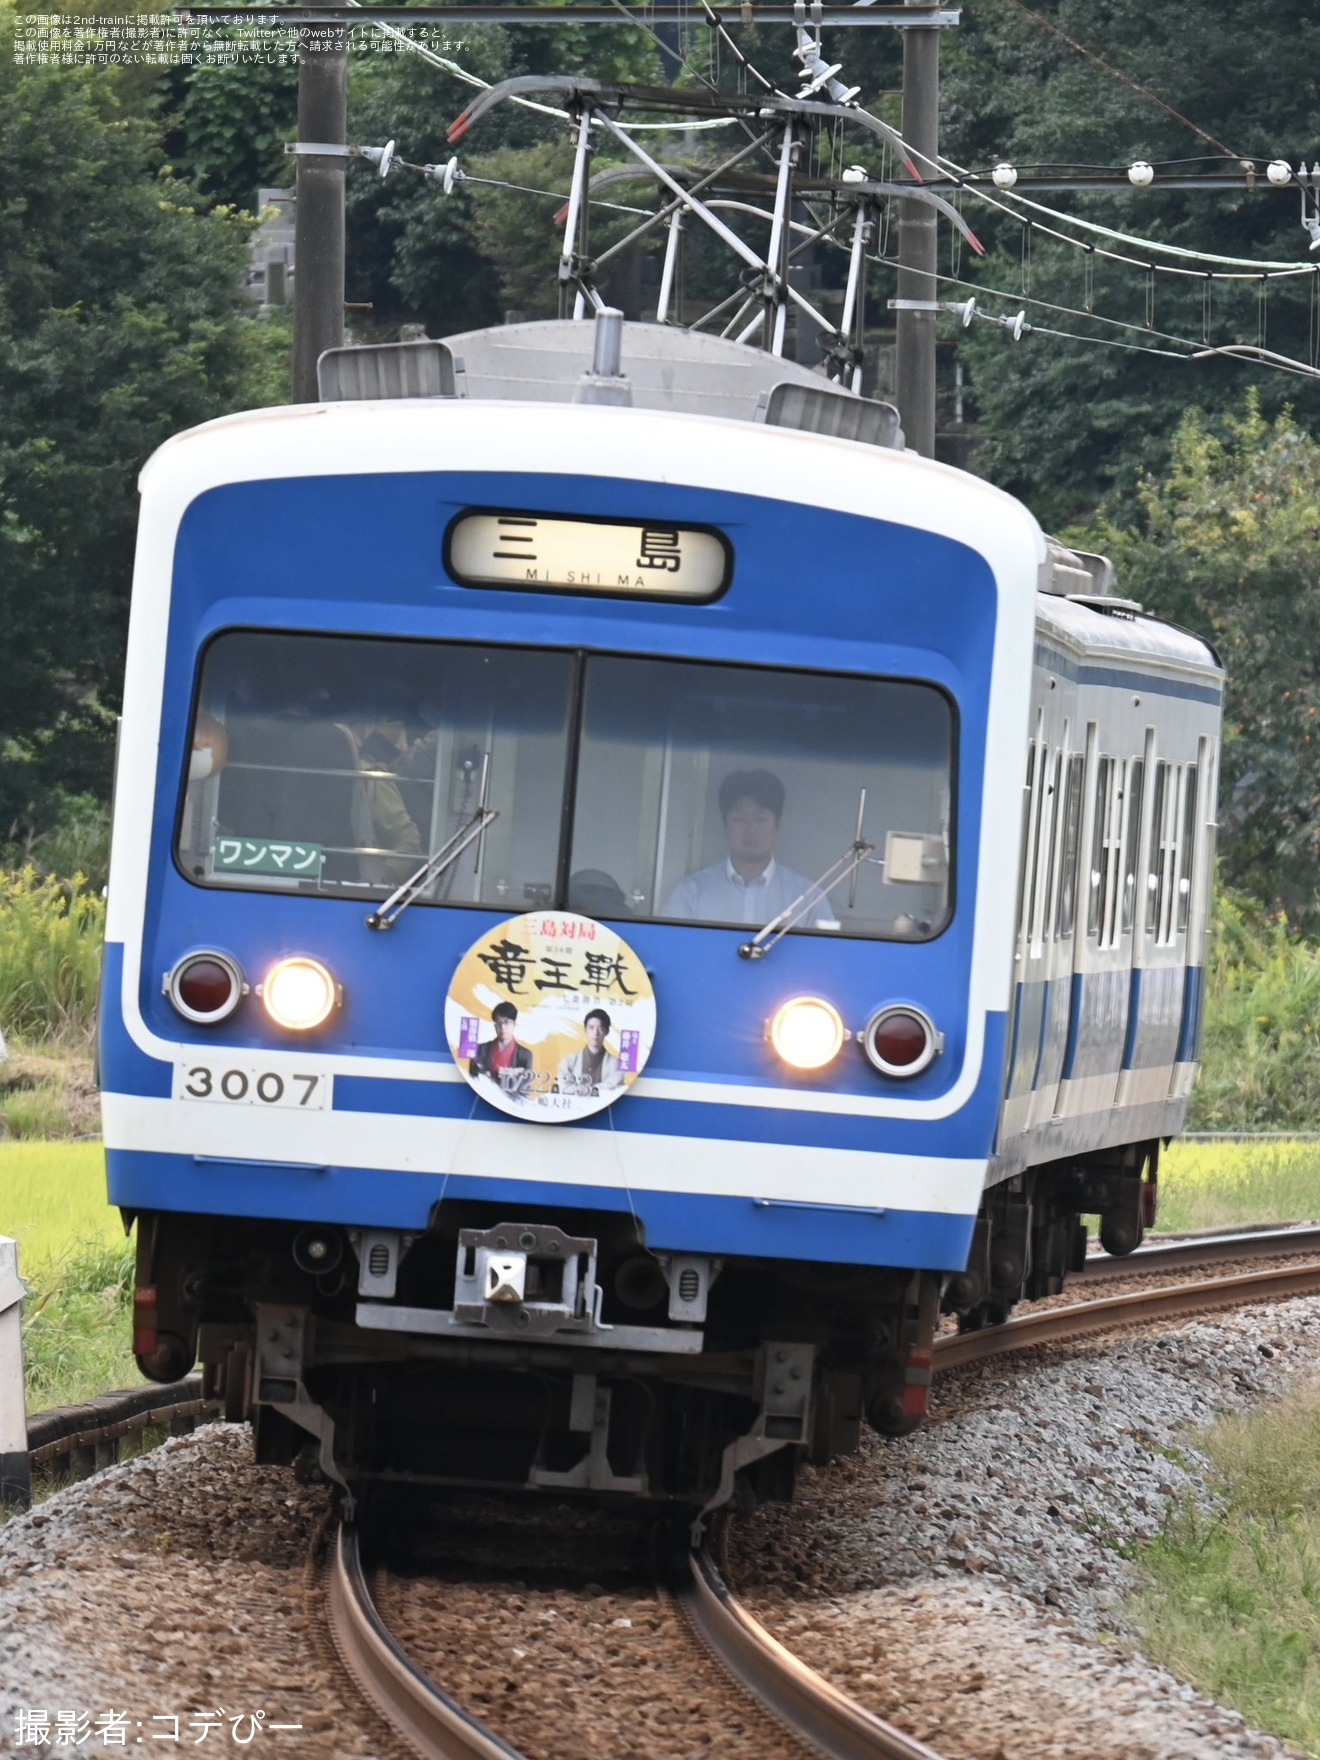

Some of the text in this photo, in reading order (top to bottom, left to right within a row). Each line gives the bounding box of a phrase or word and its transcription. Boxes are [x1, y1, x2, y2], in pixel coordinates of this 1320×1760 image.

[493, 518, 682, 573] 三島
[220, 840, 317, 870] ワンマン
[521, 918, 597, 941] 三島対局
[185, 1066, 319, 1106] 3007
